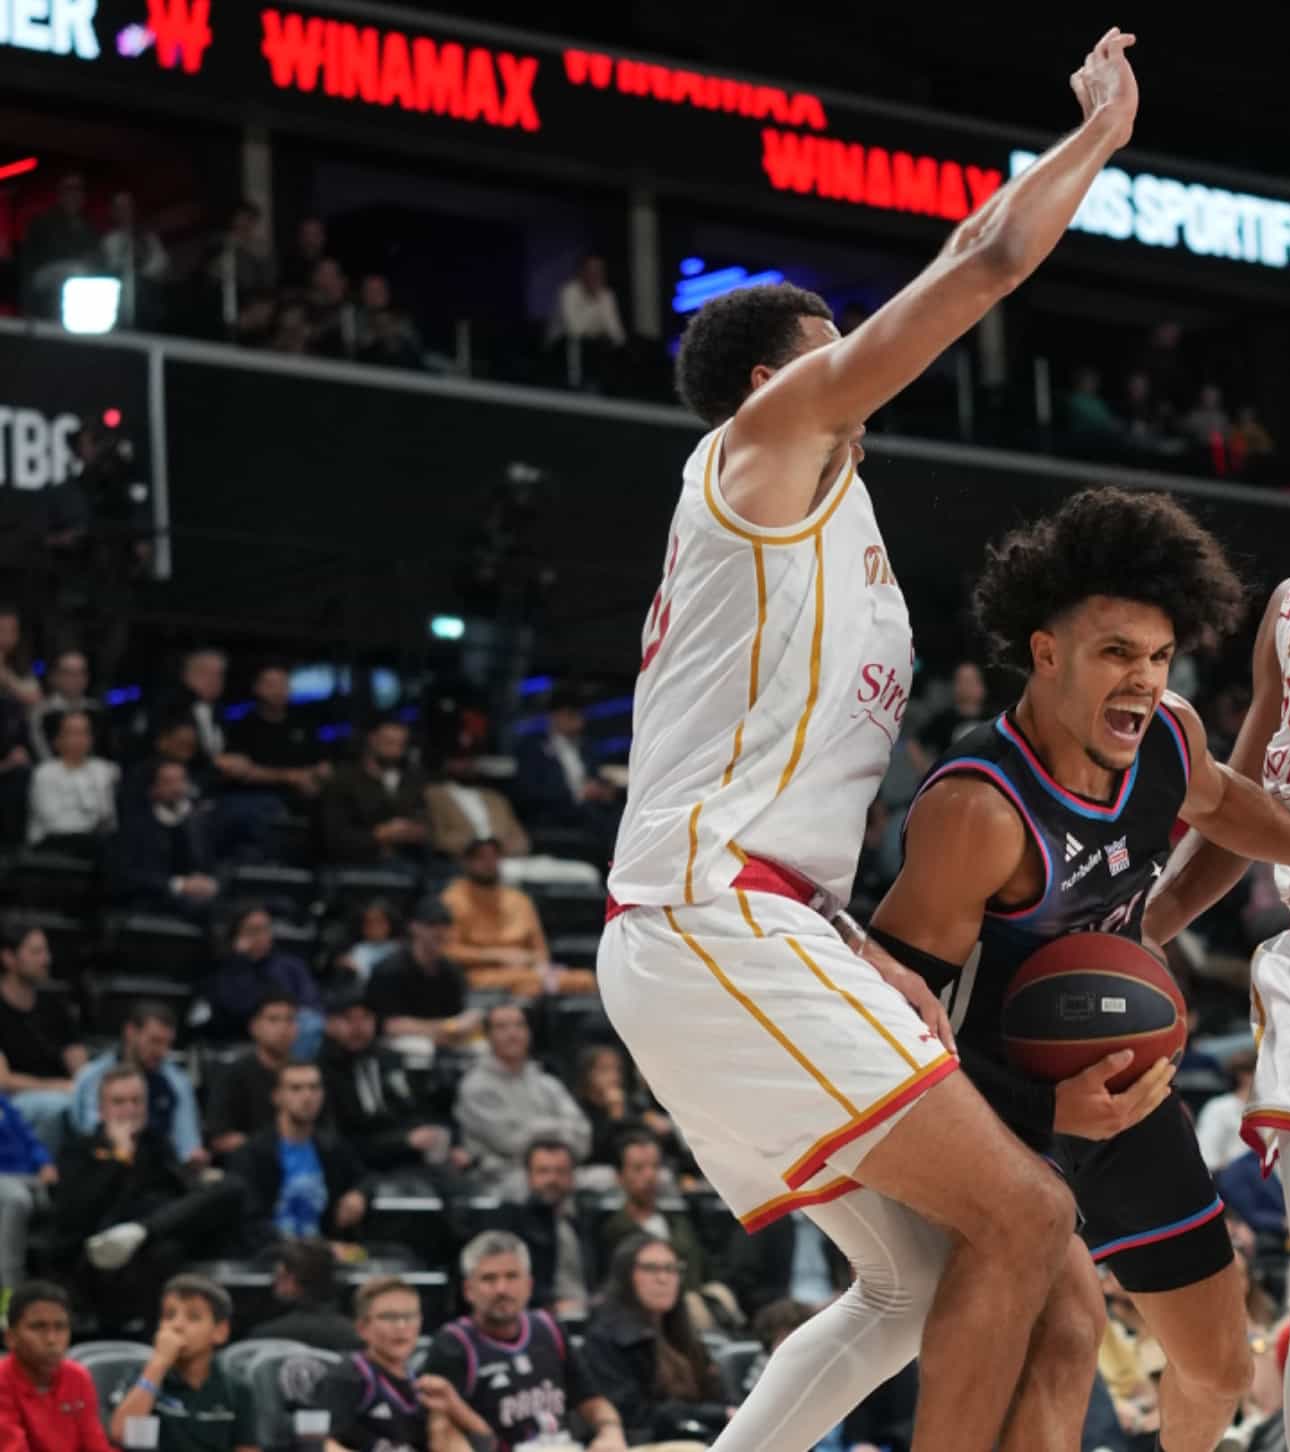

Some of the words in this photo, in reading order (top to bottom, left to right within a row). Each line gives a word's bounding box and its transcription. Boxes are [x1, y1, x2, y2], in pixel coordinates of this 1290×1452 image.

[0, 0, 100, 60] ER
[261, 9, 541, 132] WINAMAX
[761, 127, 1003, 222] WINAMAX
